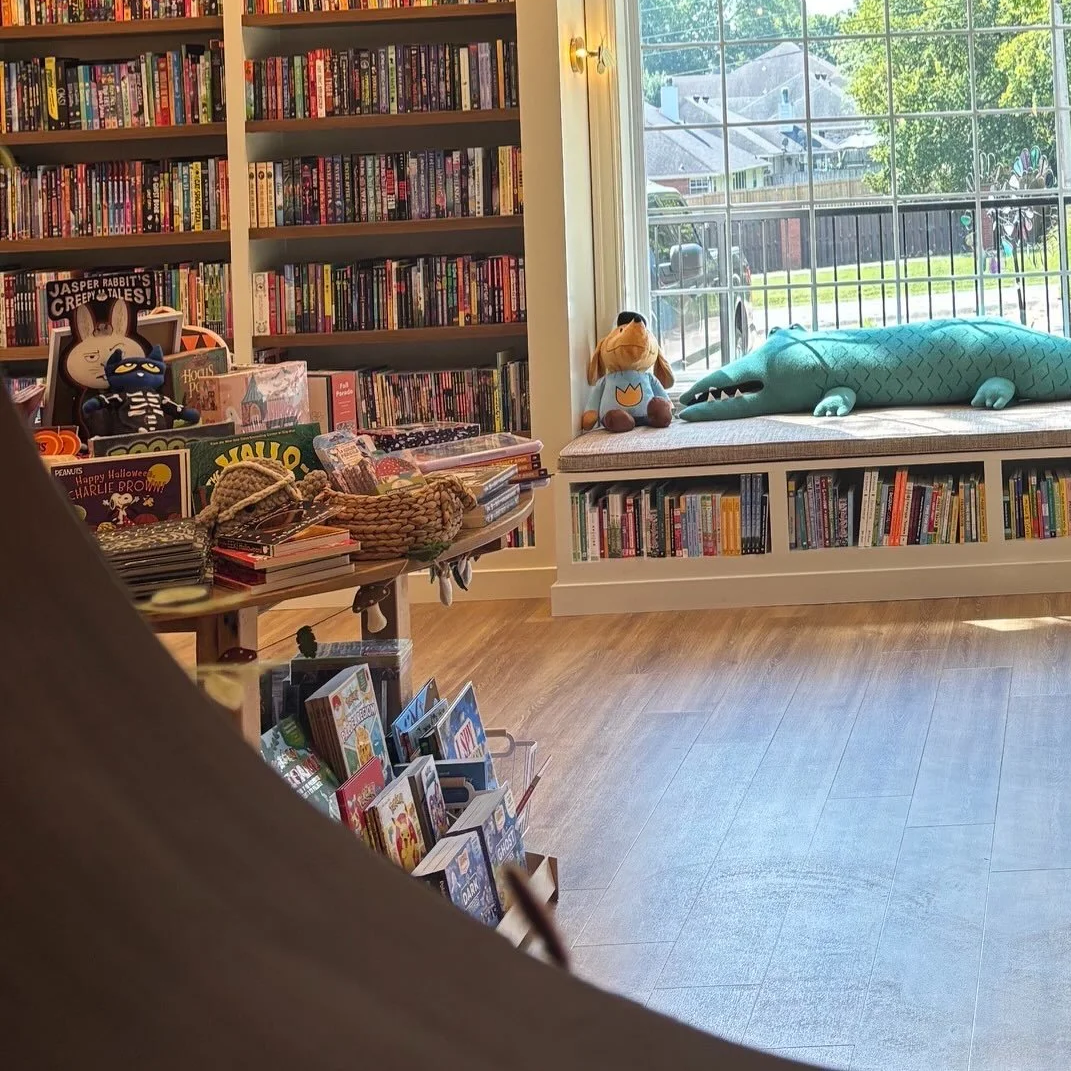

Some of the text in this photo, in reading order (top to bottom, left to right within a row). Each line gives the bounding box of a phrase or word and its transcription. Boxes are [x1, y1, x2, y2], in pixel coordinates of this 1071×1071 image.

[49, 274, 150, 297] JASPER RABBIT'S
[50, 287, 151, 317] CREEPY TALES!
[182, 363, 214, 384] HOCUS
[336, 389, 354, 398] Parade
[339, 382, 349, 390] Fall
[54, 467, 83, 477] PEANUTS
[75, 474, 105, 486] Happy
[68, 480, 166, 501] CHARLIE BROWN!
[497, 832, 517, 861] GHOST
[461, 877, 480, 907] DARK
